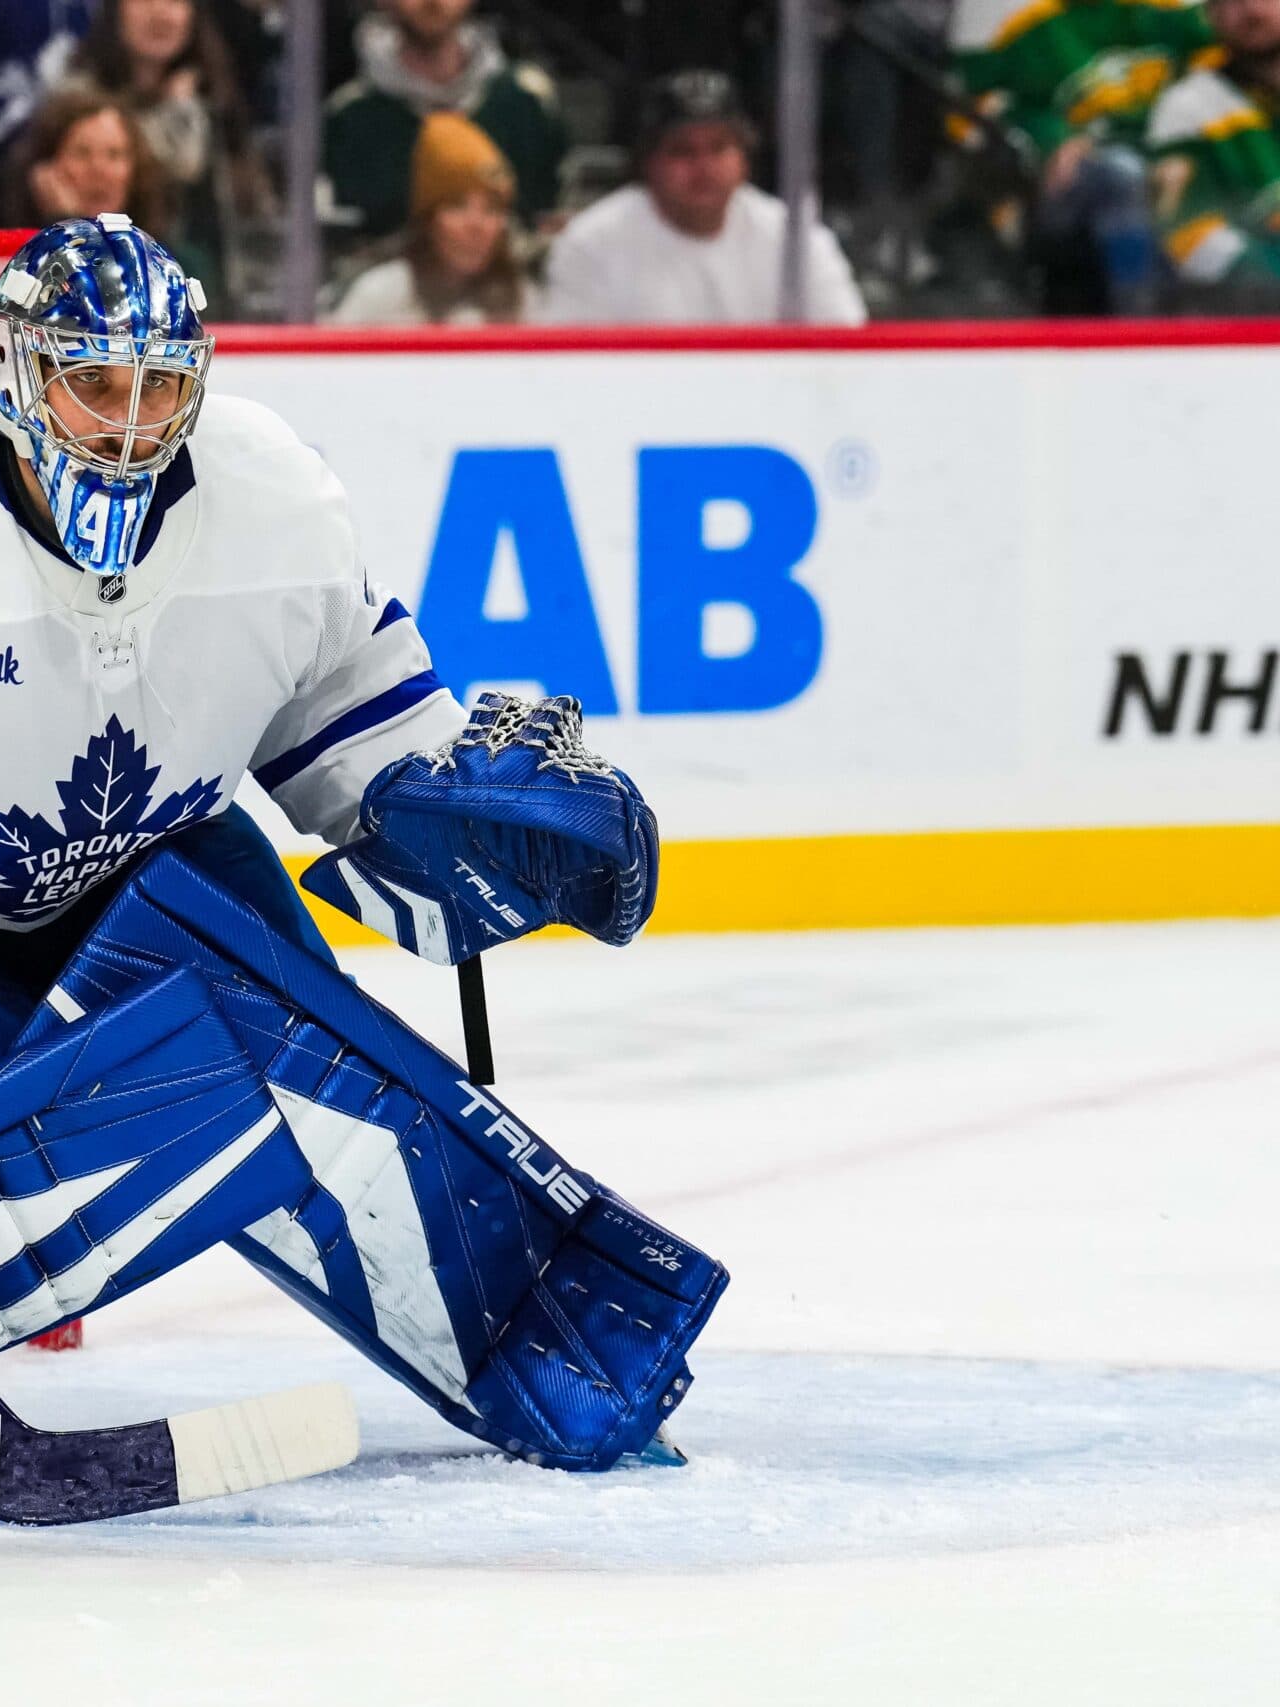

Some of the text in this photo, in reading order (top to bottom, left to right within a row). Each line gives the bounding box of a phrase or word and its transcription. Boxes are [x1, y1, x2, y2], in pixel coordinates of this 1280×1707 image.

[77, 491, 137, 563] 41
[23, 865, 122, 904] LEAF
[455, 856, 526, 928] TRUE
[456, 1080, 591, 1215] TRUE
